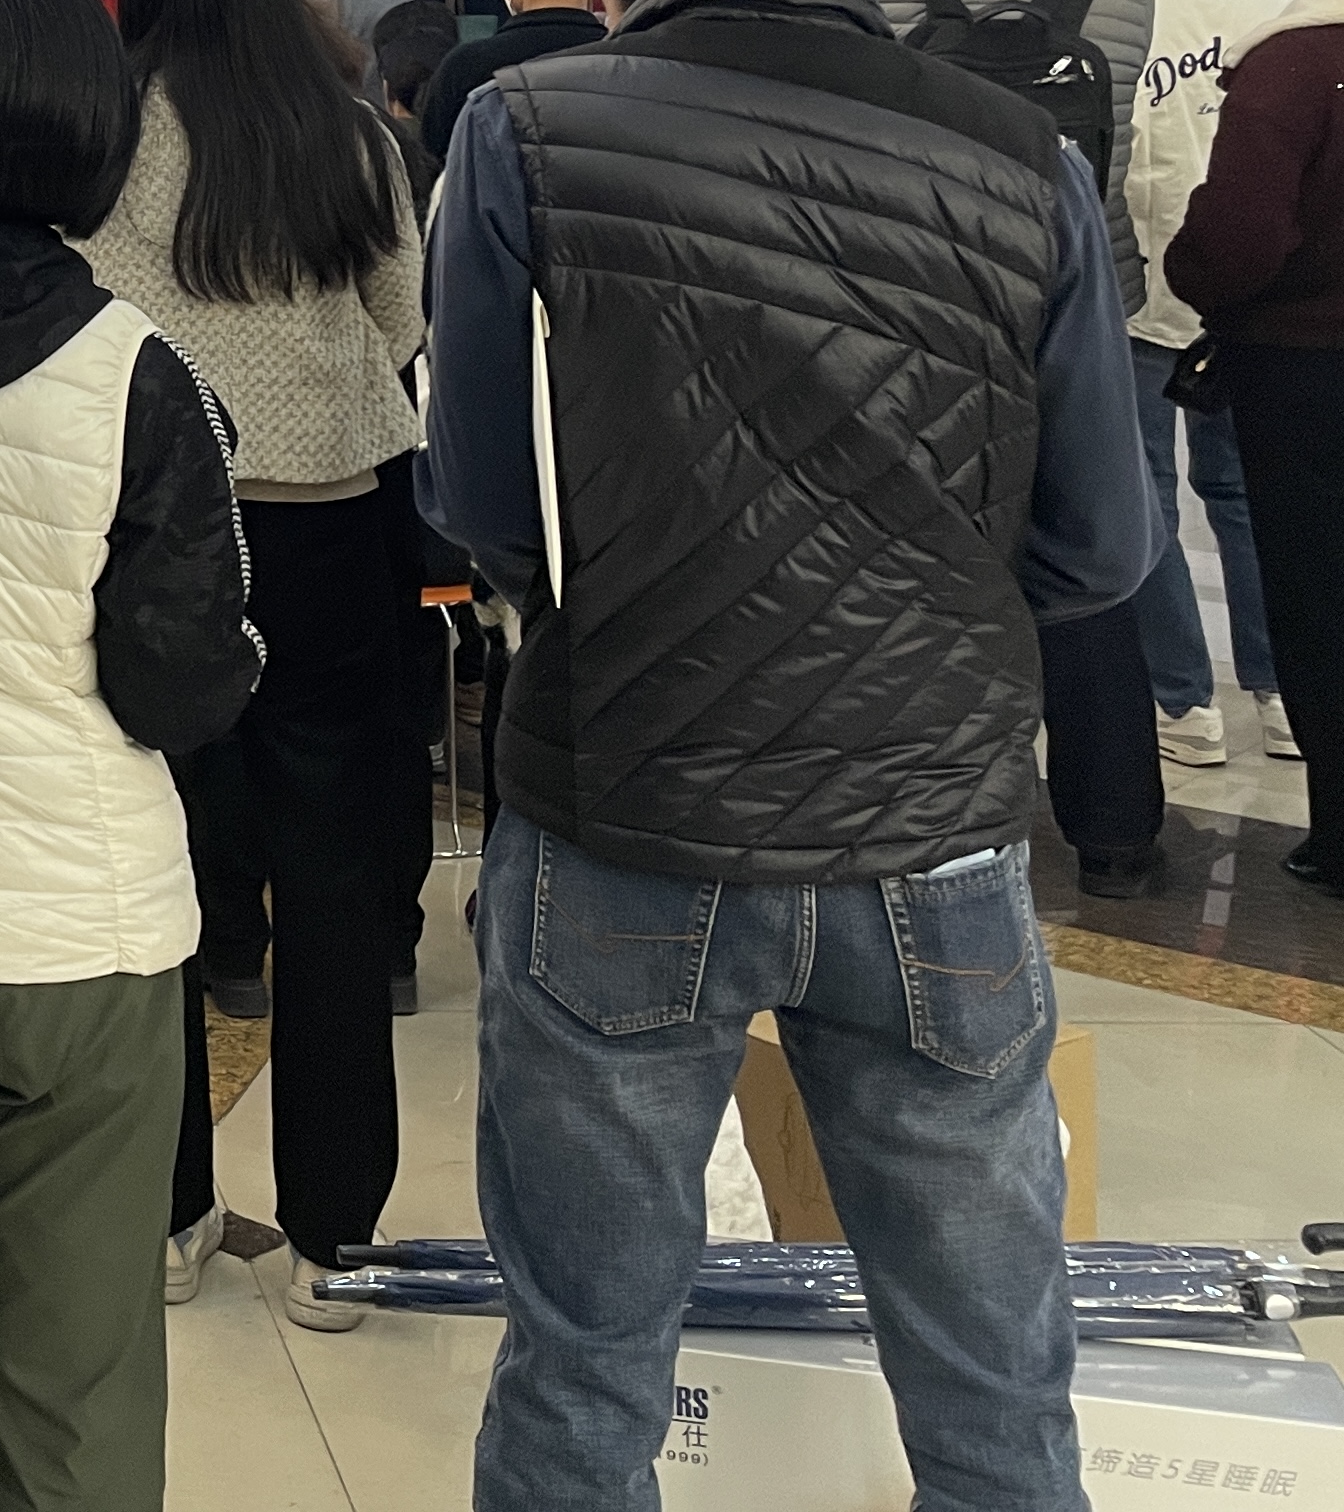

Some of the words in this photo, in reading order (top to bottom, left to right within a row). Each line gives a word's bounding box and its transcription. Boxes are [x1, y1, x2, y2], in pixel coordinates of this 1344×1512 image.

[1144, 35, 1224, 108] Dod
[675, 1385, 709, 1420] RS
[682, 1425, 709, 1449] 仕
